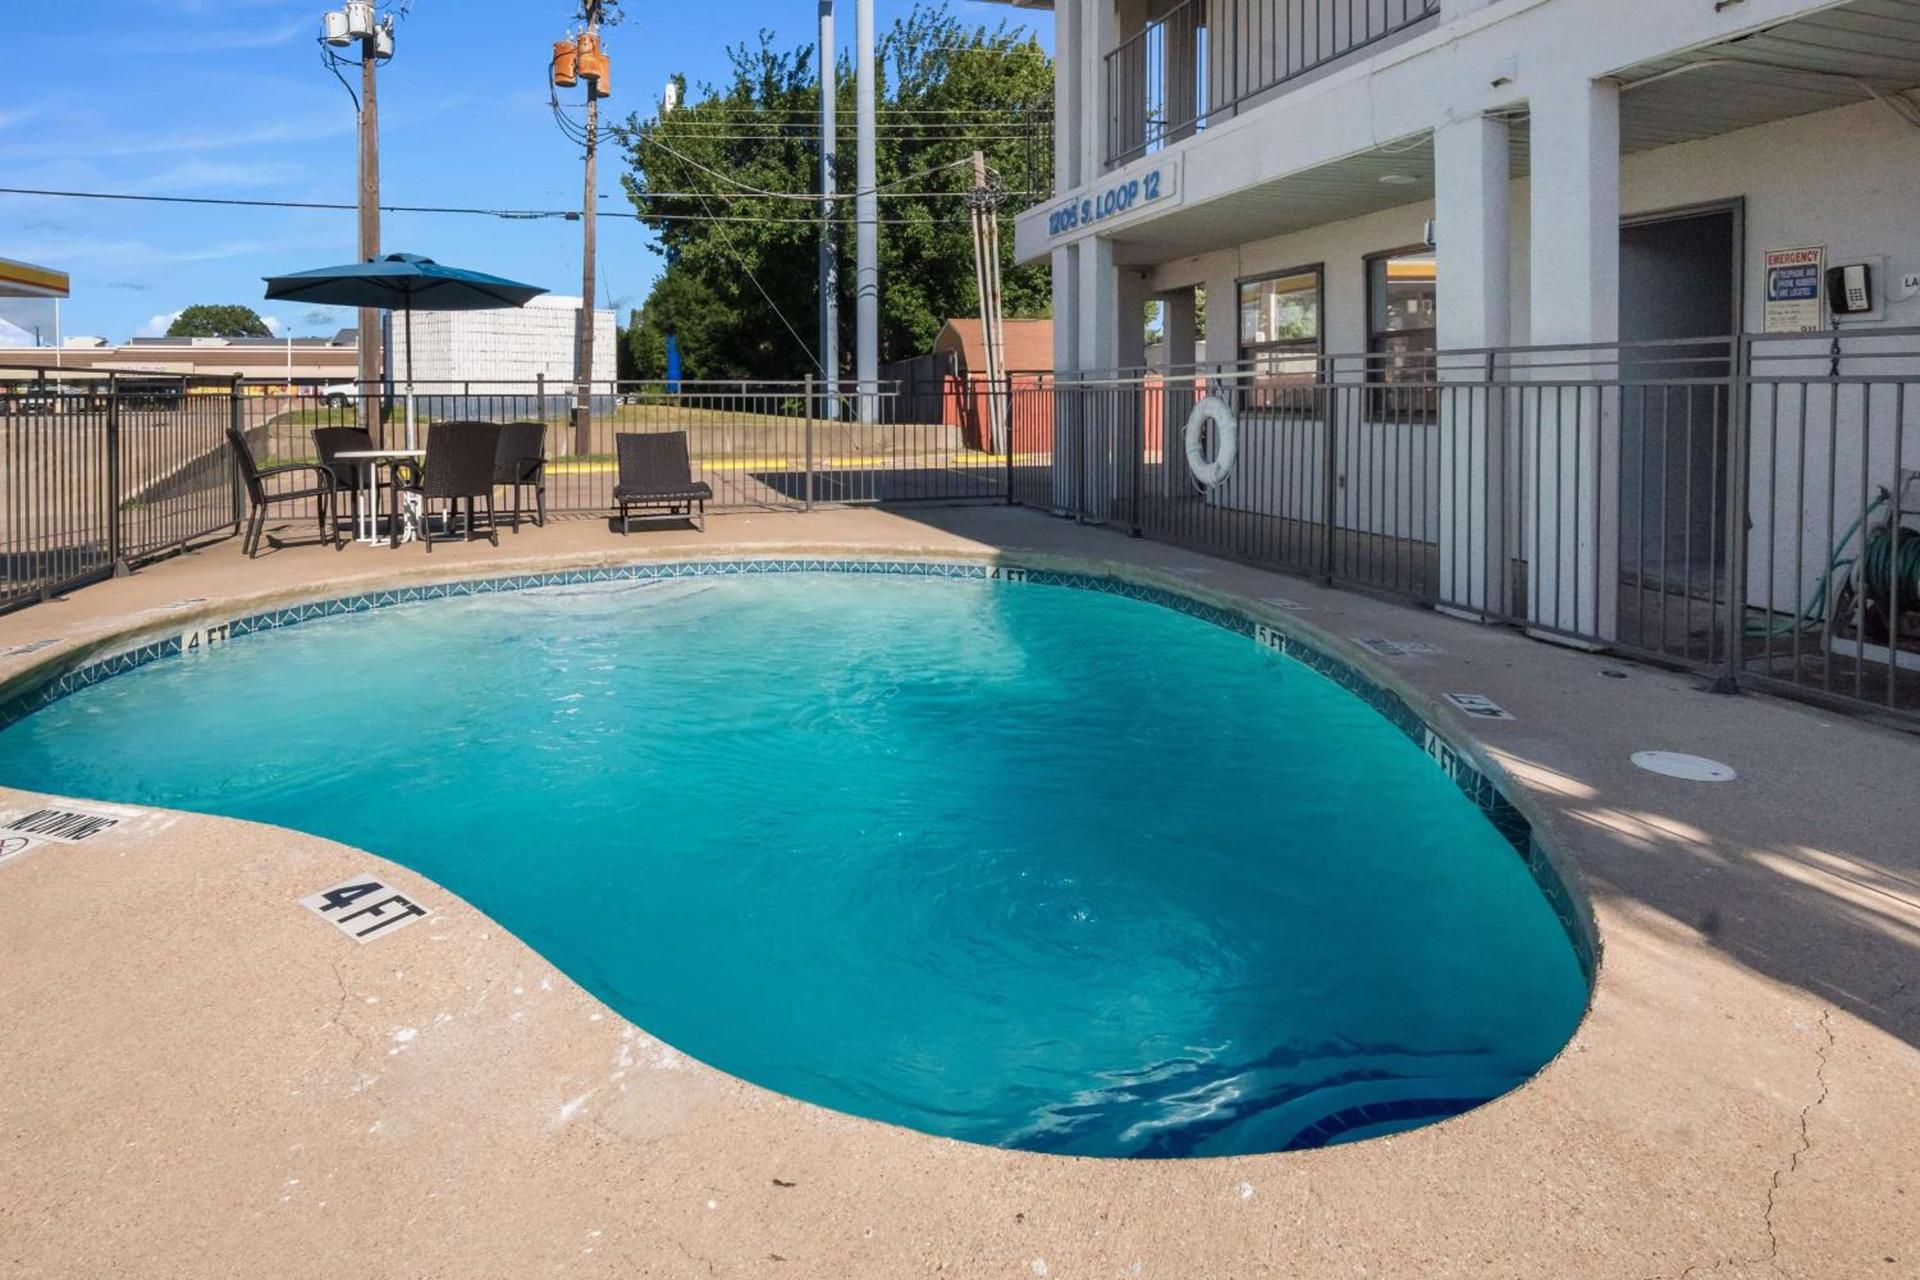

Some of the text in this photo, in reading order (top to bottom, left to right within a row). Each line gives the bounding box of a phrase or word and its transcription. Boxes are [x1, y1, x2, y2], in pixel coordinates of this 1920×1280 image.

[1049, 204, 1078, 235] 1205
[1096, 180, 1138, 220] LOOP
[1143, 171, 1160, 200] 12
[1768, 250, 1819, 265] EMERGENCY
[1007, 569, 1025, 582] FT
[188, 624, 228, 649] 4 FT
[1271, 632, 1285, 652] FT
[1428, 735, 1456, 780] 4 FT
